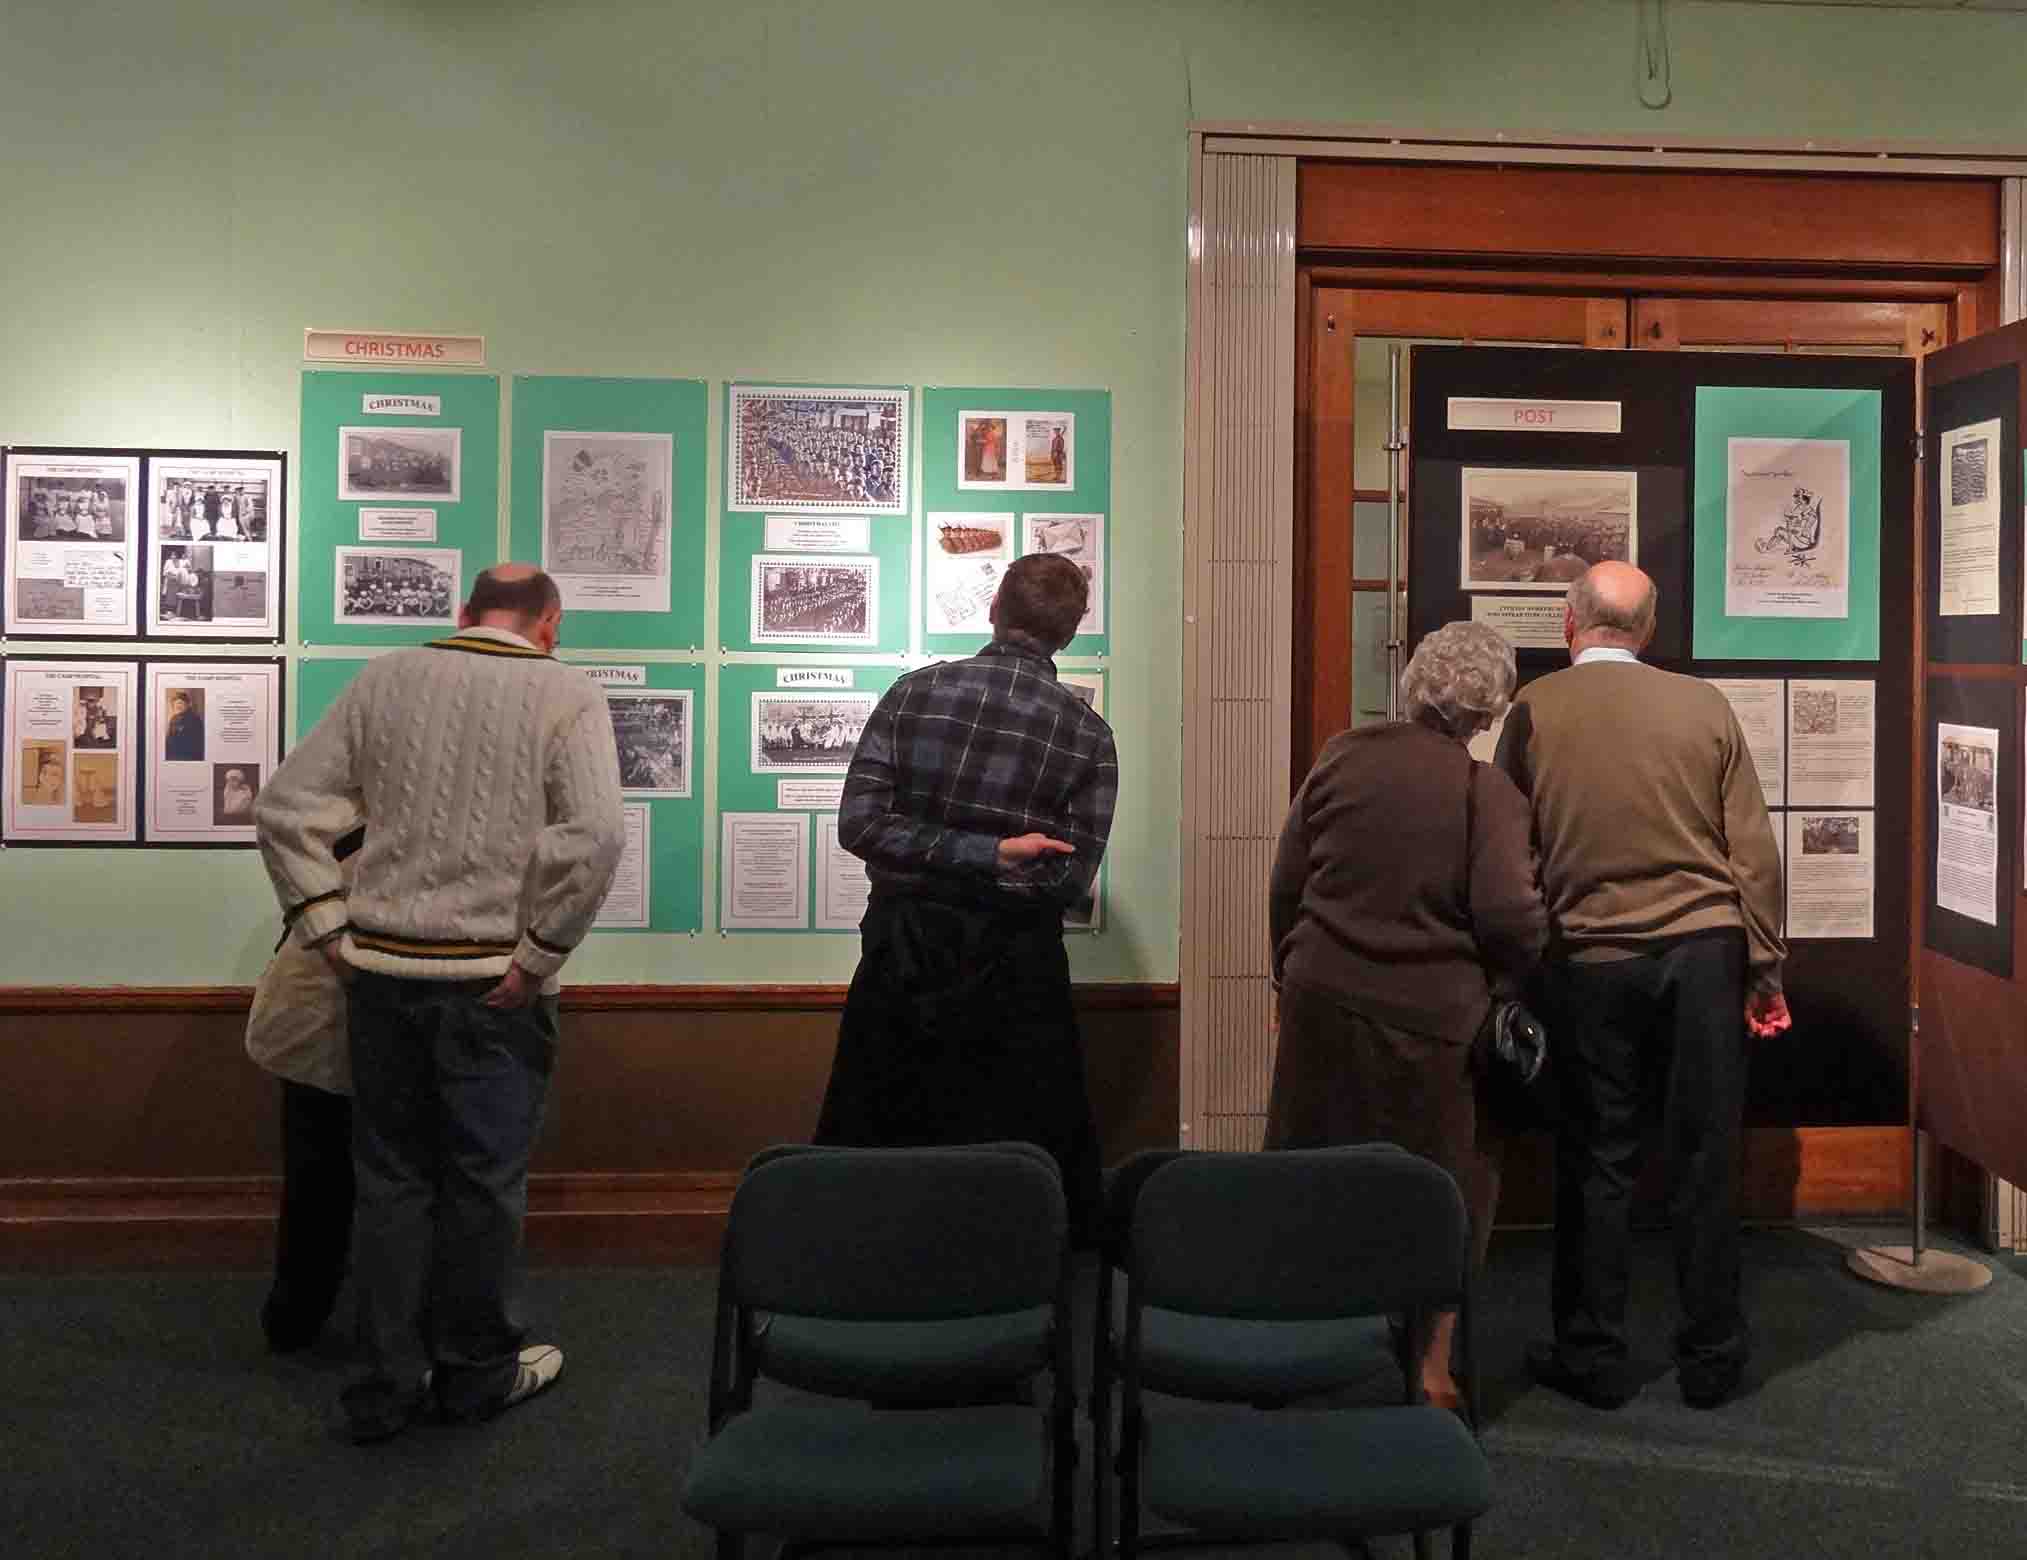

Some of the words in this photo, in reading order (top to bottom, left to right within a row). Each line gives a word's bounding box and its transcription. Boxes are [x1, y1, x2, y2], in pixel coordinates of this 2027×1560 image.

[345, 342, 444, 358] CHRISTMAS
[368, 398, 433, 412] CHRISTMAS
[1513, 408, 1554, 424] POST
[585, 669, 639, 681] RISTMAS
[783, 671, 847, 684] CHRISTMAS
